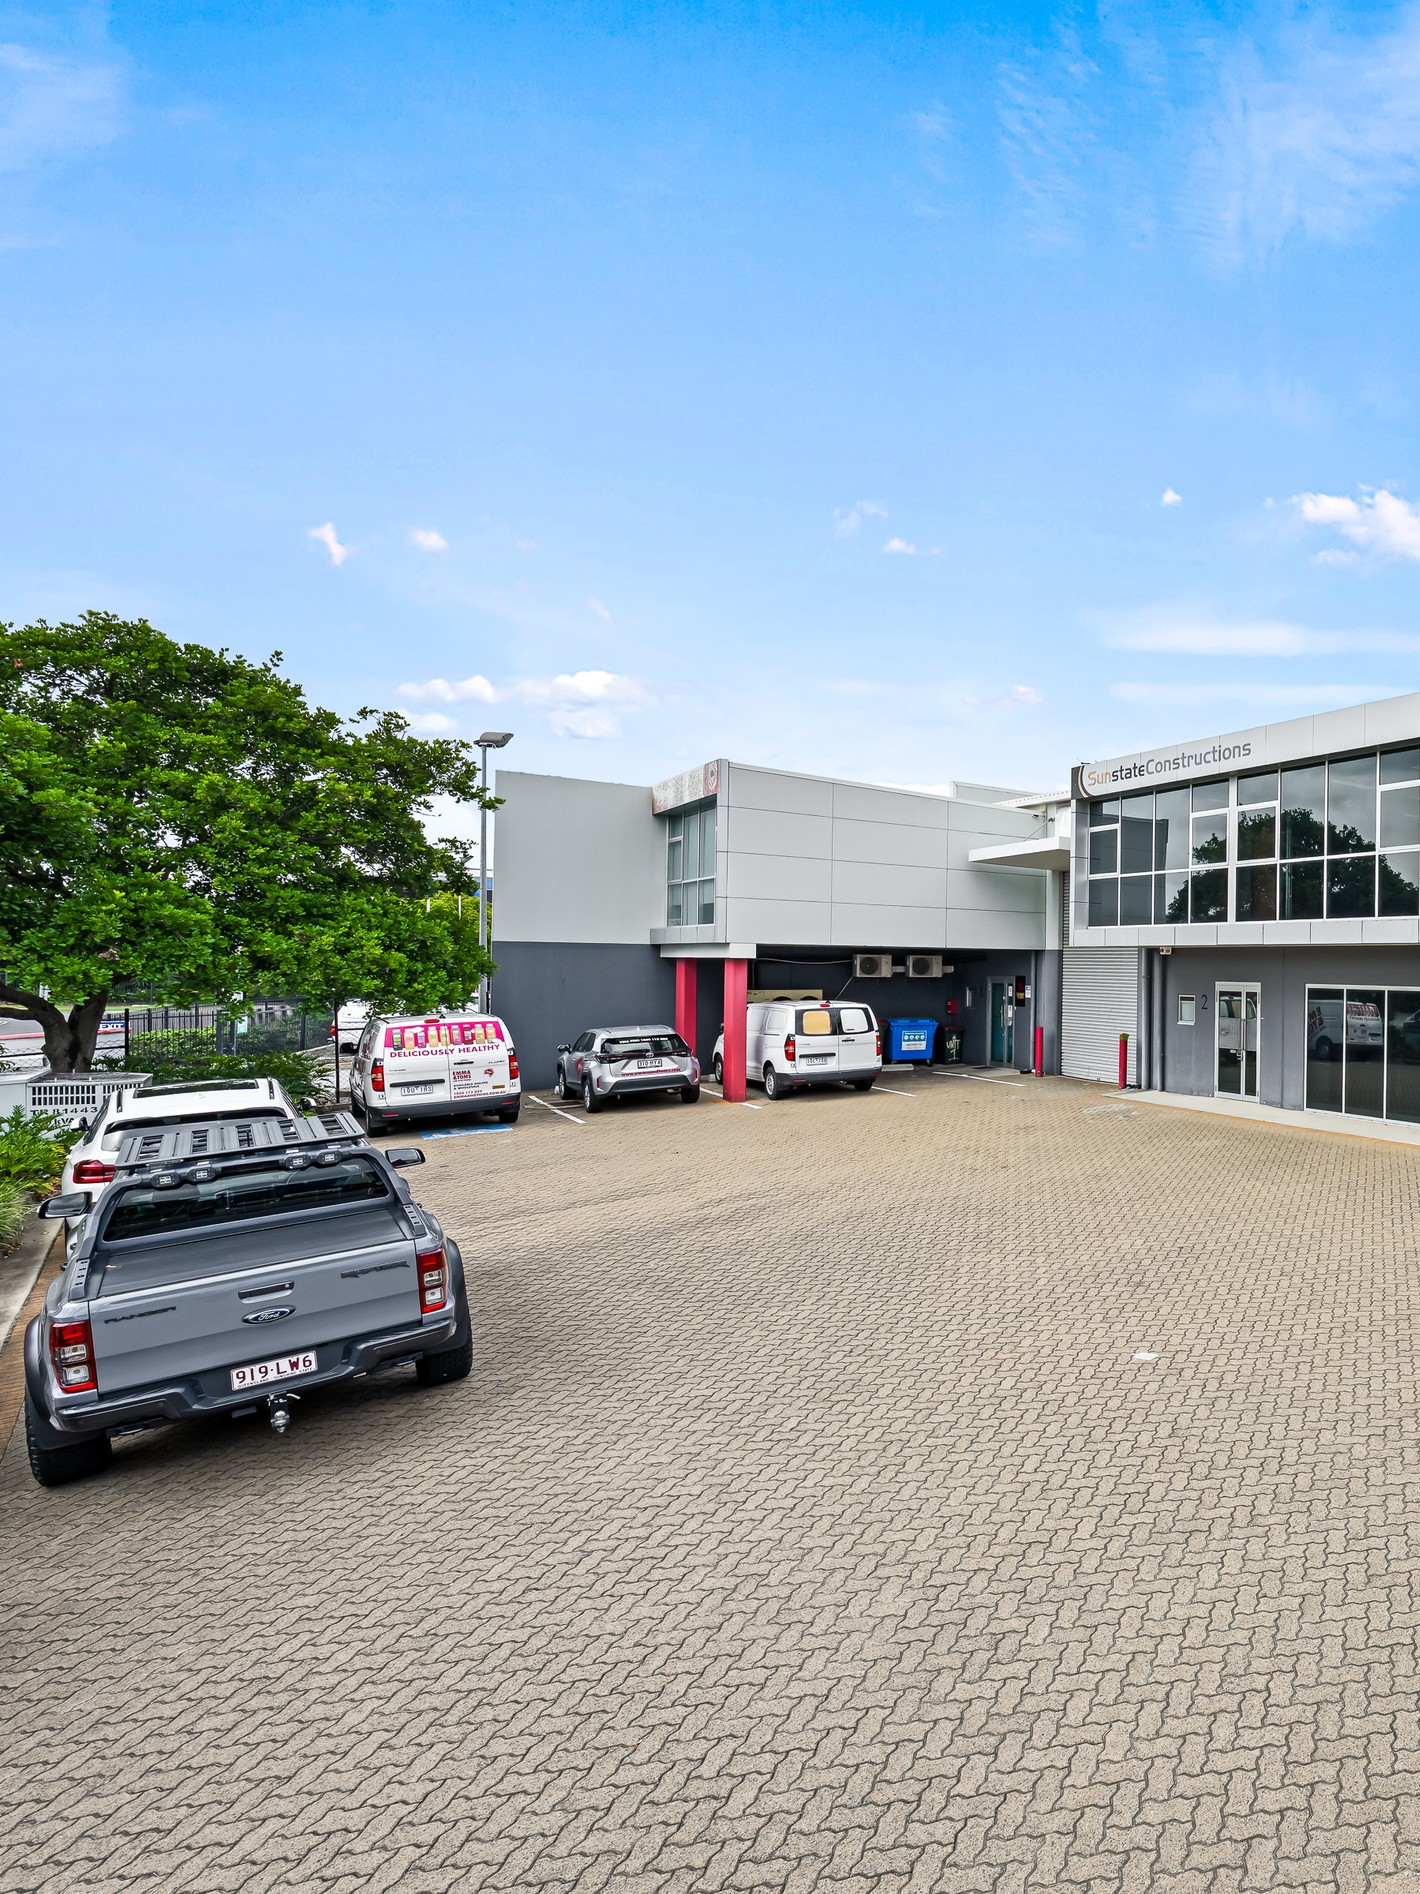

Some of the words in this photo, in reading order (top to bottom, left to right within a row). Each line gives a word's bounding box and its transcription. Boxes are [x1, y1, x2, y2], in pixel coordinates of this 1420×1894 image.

[1201, 994, 1208, 1010] 2
[390, 1048, 455, 1058] DELICIOUSLY
[458, 1044, 500, 1053] HEALTHY
[52, 1106, 99, 1115] 81443
[341, 1260, 411, 1279] RAPTOR
[104, 1306, 177, 1324] RANGER
[257, 1310, 281, 1321] Ford
